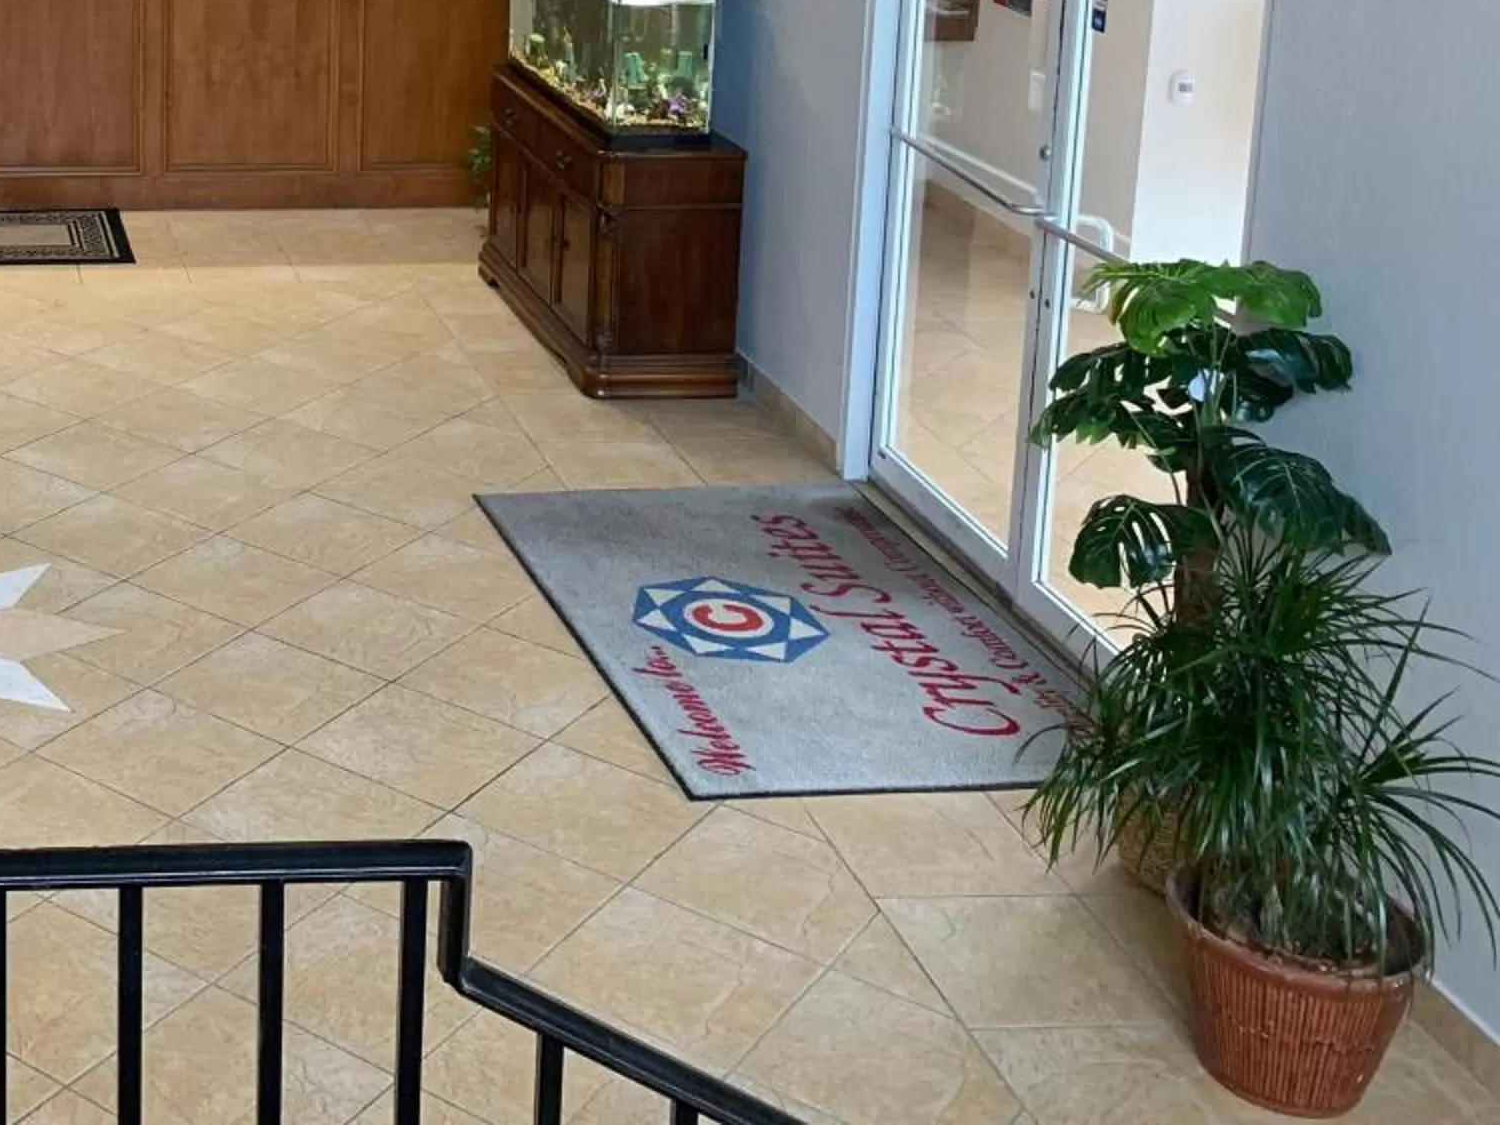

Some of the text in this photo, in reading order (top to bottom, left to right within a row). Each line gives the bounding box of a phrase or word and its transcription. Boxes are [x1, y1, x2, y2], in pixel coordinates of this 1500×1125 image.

[690, 603, 763, 632] C
[750, 513, 1021, 736] Crystal Suites
[676, 681, 757, 775] Welcome
